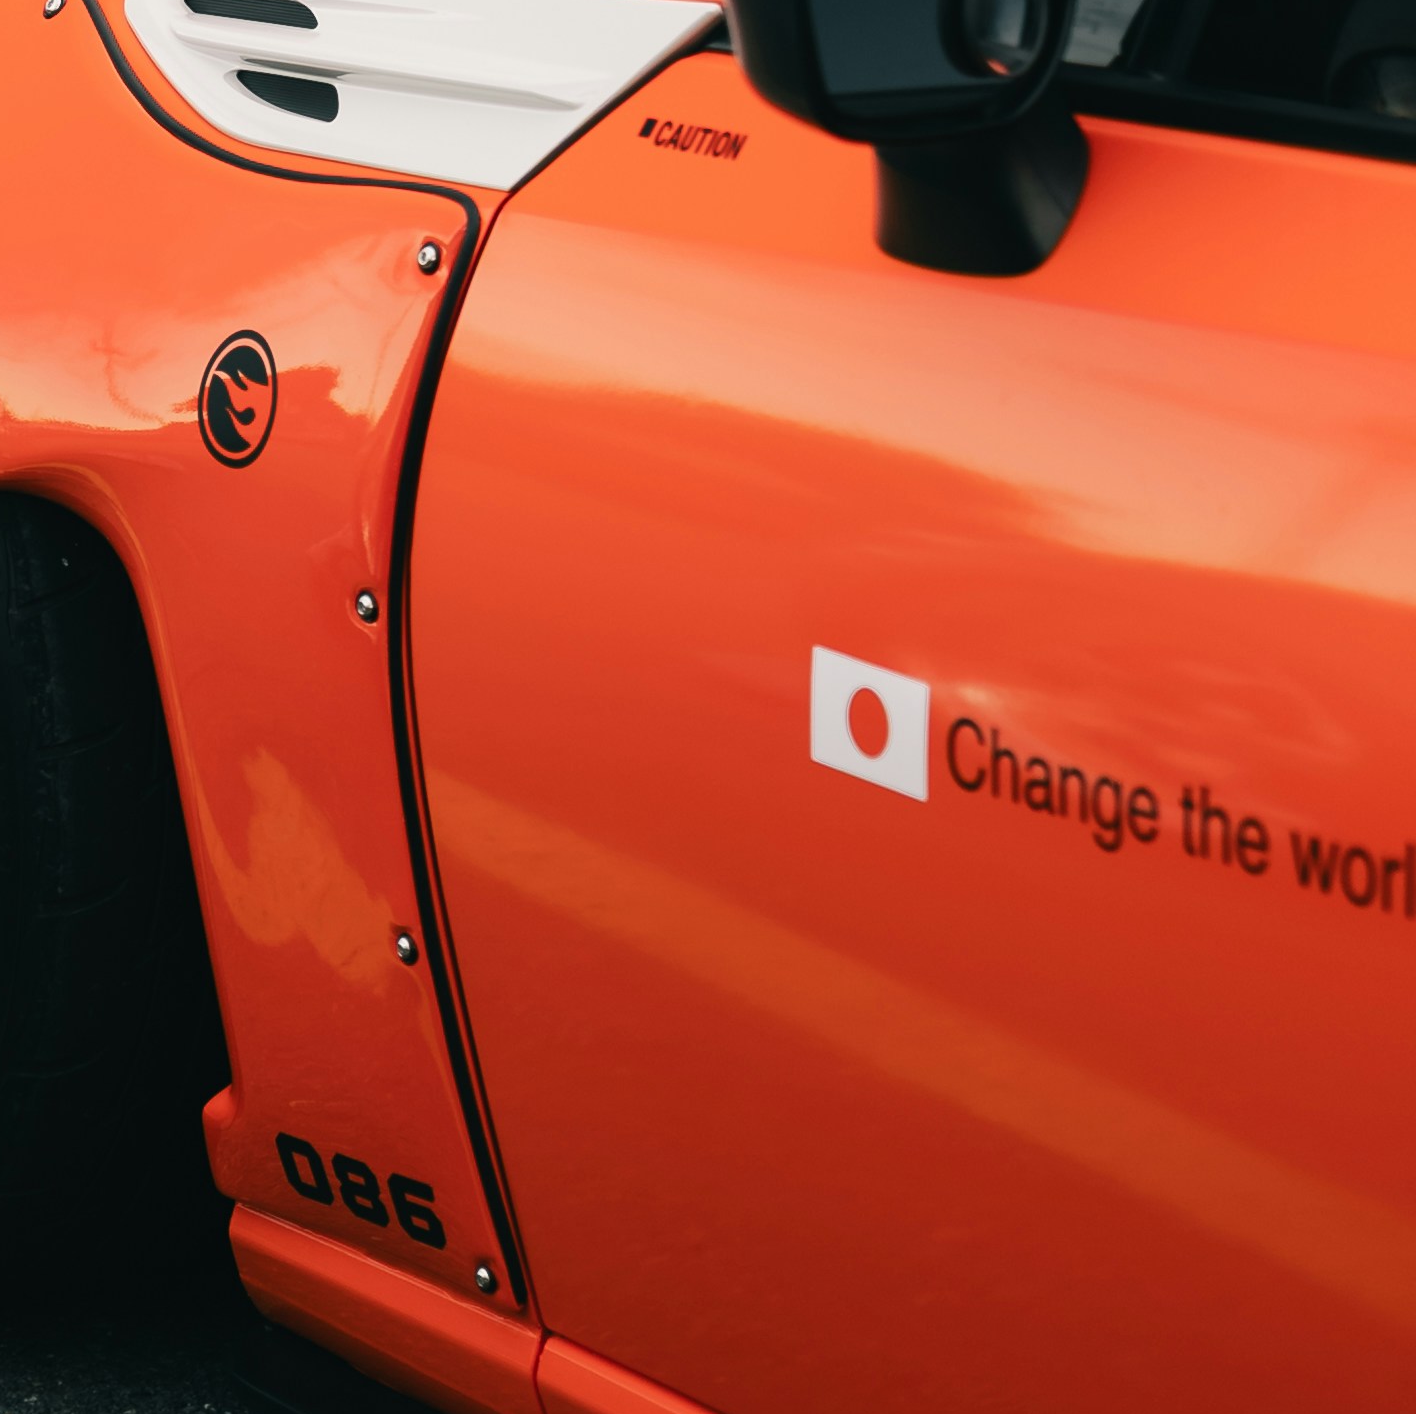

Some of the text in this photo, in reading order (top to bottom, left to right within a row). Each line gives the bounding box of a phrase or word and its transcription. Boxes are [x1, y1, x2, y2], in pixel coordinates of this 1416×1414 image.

[654, 121, 747, 160] CAUTION
[946, 717, 1161, 853] Change
[1179, 781, 1271, 877] the
[275, 1131, 447, 1251] 086
